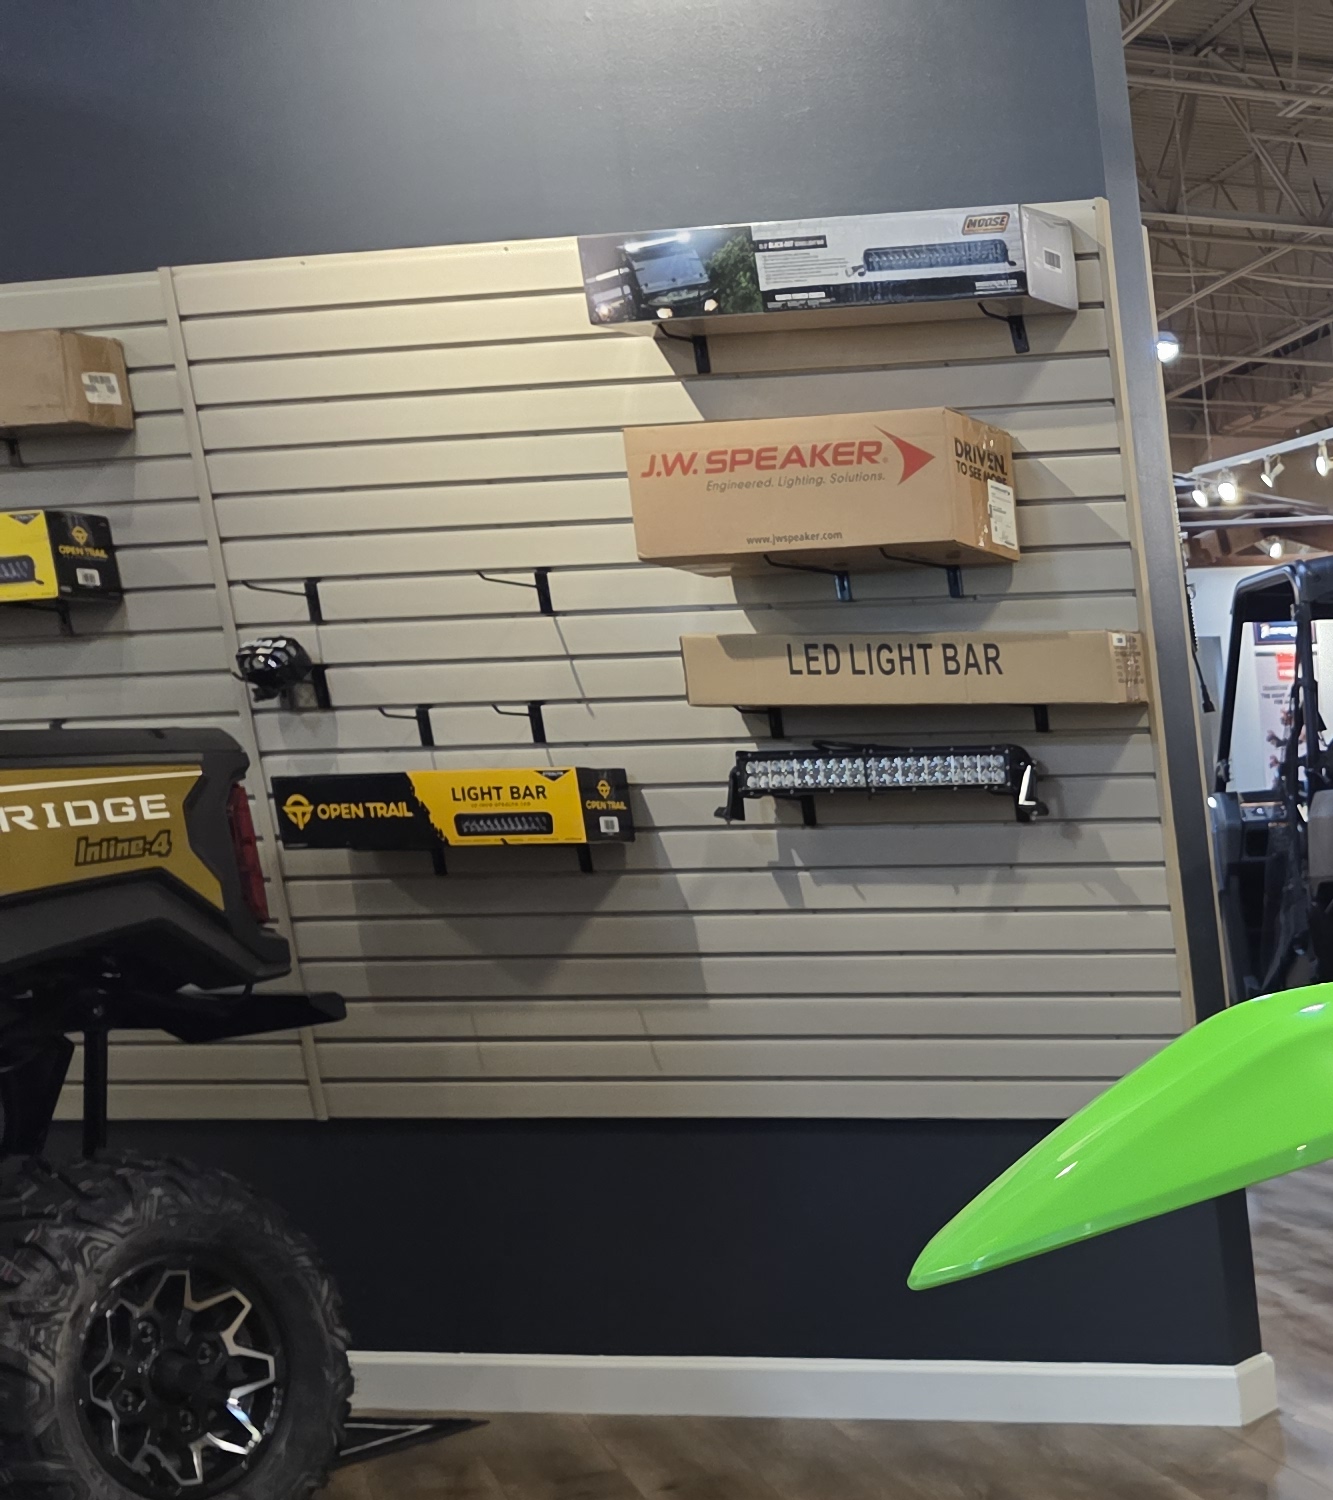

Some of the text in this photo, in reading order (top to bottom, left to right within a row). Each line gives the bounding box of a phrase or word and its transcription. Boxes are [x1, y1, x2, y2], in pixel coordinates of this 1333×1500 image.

[966, 215, 1007, 229] MOOSE
[640, 440, 883, 478] J.W. SPEAKER
[955, 460, 968, 475] TO
[968, 465, 982, 481] SEE
[706, 471, 886, 493] Engineered. Lighting. Solutions.
[746, 530, 843, 545] www.jwspeaker.com
[786, 643, 1004, 676] LED LIGHT BAR
[451, 785, 548, 802] LIGHT BAR
[0, 794, 171, 833] RIDGE
[317, 801, 414, 819] OPEN TRAIL
[585, 800, 607, 810] OPEN
